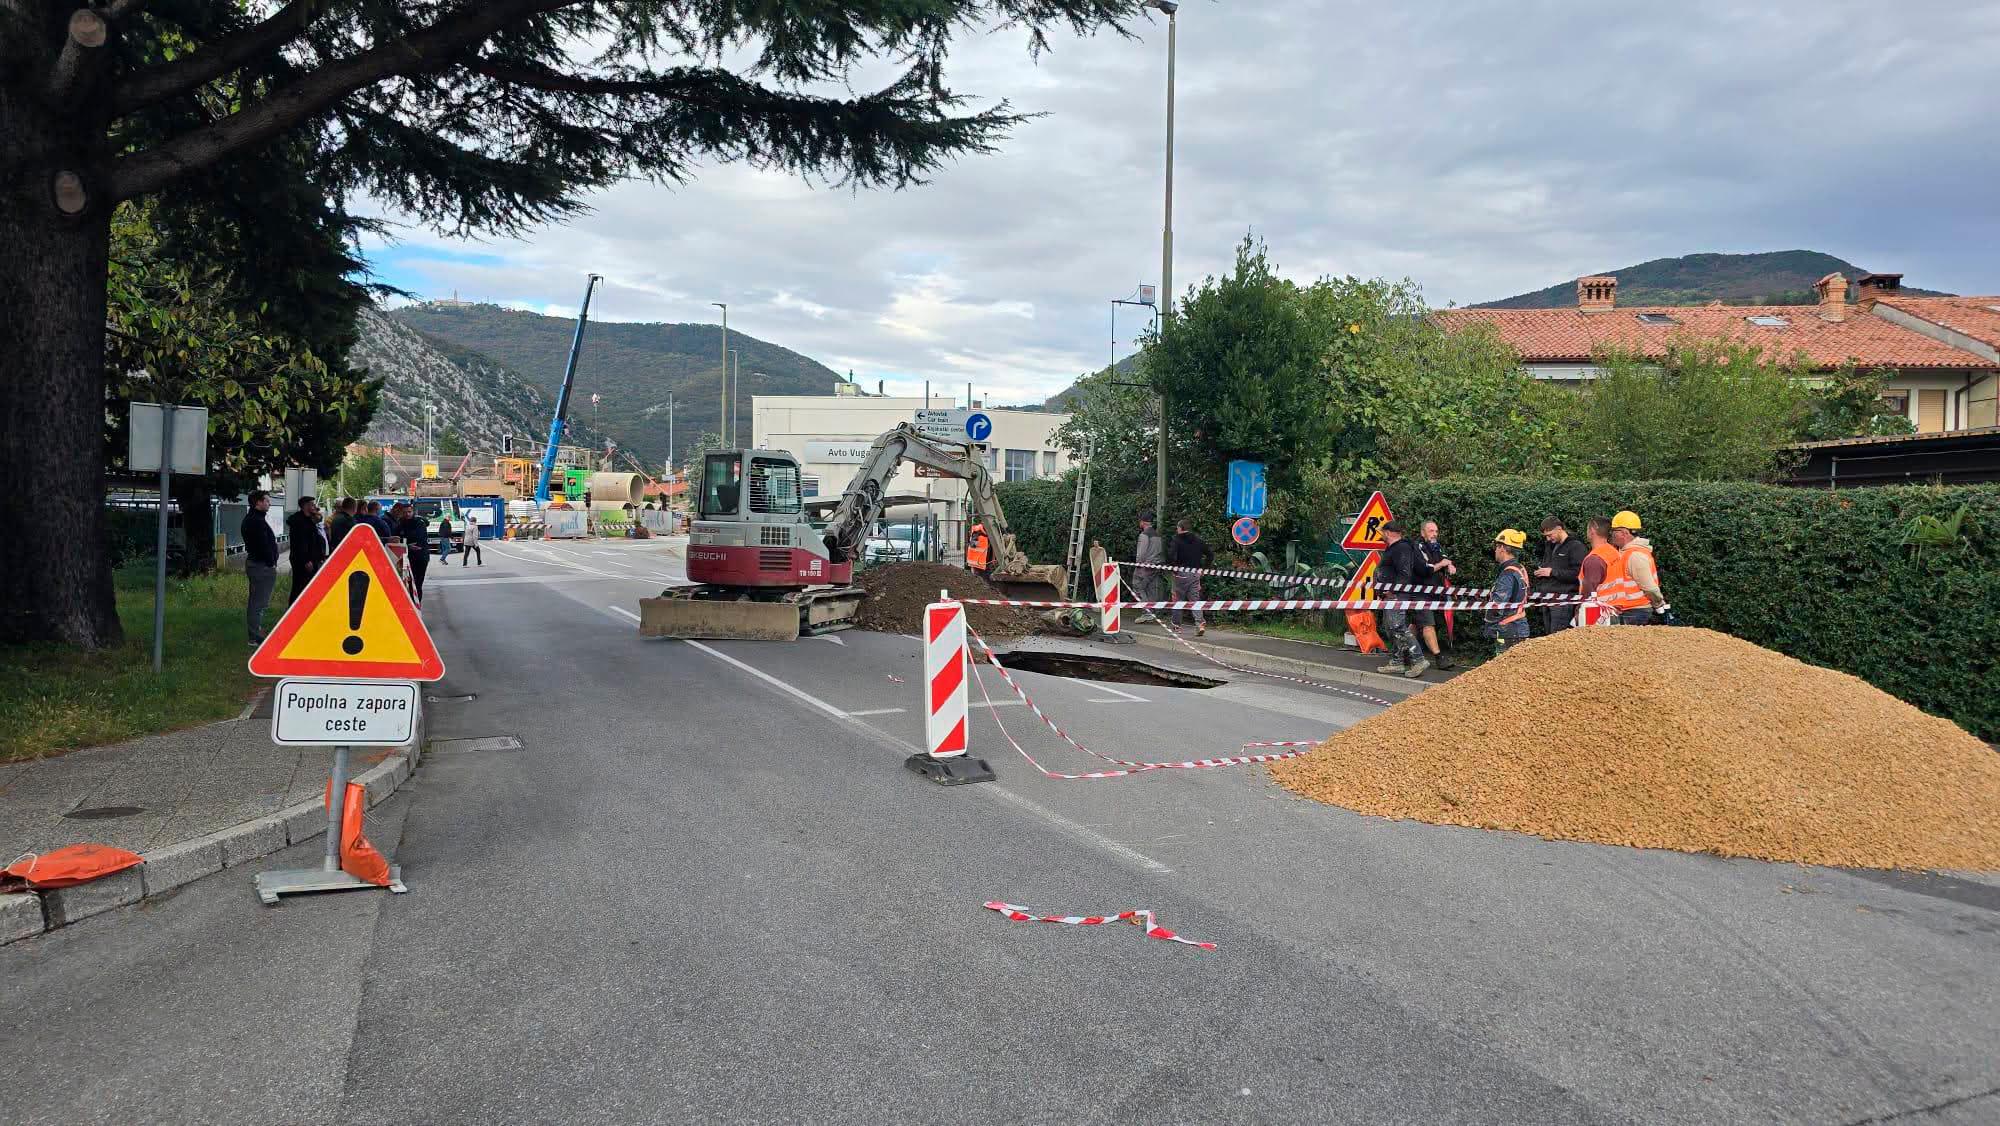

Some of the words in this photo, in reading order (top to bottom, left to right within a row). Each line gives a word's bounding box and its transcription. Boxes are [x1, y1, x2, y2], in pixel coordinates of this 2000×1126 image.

[828, 448, 847, 457] Avto
[850, 448, 870, 459] Vuga
[287, 693, 347, 713] Popolna
[356, 697, 407, 714] zapora
[325, 717, 367, 731] ceste
